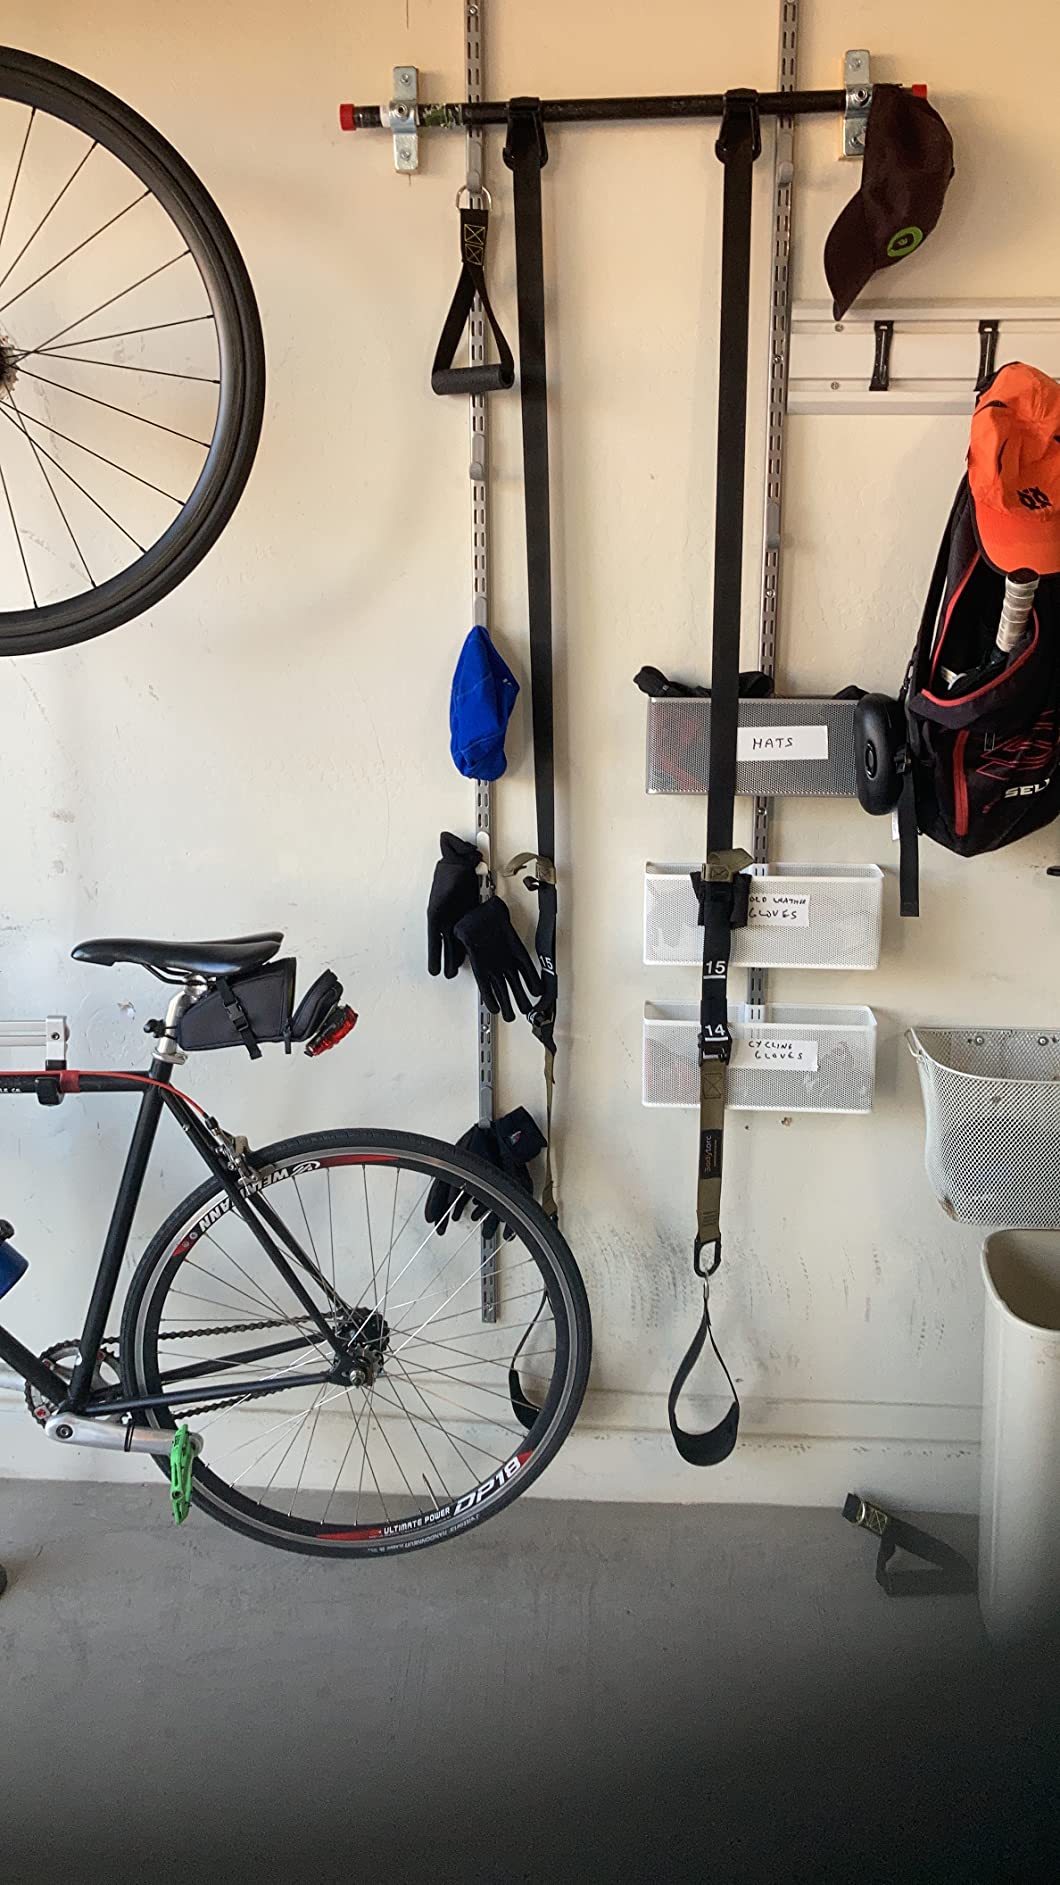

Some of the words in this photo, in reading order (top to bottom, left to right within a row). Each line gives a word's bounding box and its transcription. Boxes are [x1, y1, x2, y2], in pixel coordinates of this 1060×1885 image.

[752, 737, 793, 750] HATS
[1004, 778, 1050, 798] SEL
[748, 907, 797, 919] GLOVES
[540, 955, 553, 970] 15
[705, 960, 726, 974] 15
[705, 1023, 726, 1036] 14
[755, 1050, 802, 1059] GLOVES
[199, 1167, 289, 1232] WEINANN
[453, 1456, 521, 1516] DP18
[383, 1517, 422, 1535] ULTIMATE
[424, 1507, 450, 1526] POWER
